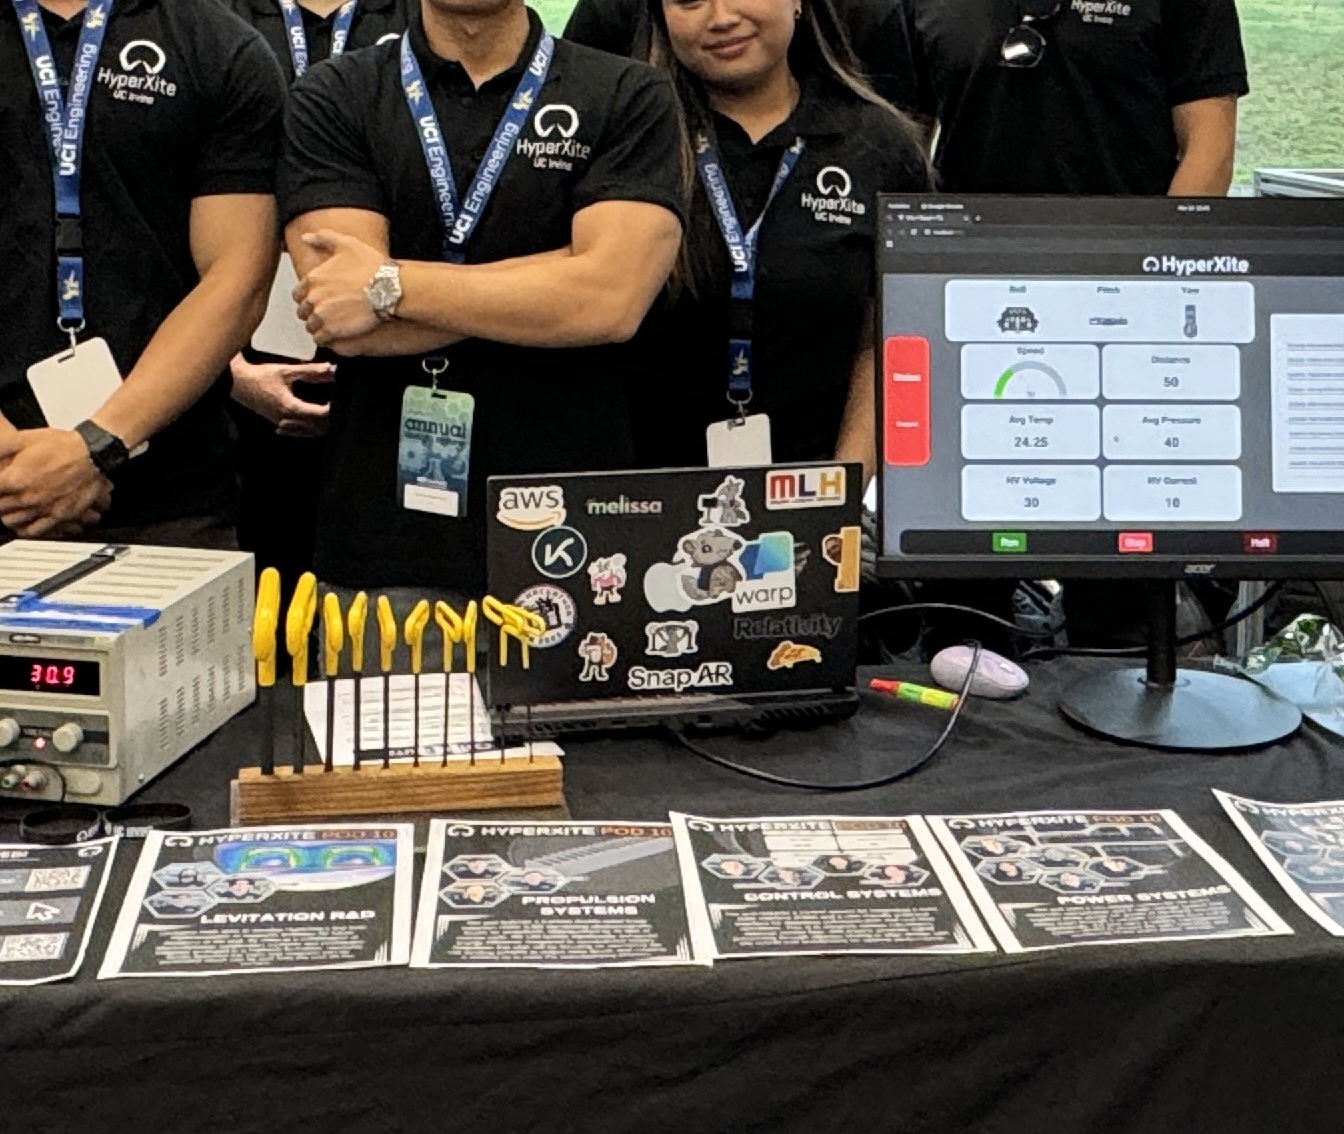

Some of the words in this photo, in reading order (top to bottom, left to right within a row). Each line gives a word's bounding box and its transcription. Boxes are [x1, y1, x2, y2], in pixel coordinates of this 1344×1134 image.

[290, 26, 305, 50] UCI
[35, 55, 56, 86] UCI
[529, 49, 548, 77] UCI
[96, 66, 177, 97] HyperXite
[64, 43, 98, 140] Engineering
[113, 89, 127, 101] UC
[419, 115, 438, 144] UCI
[516, 137, 591, 162] HyperXite
[59, 144, 76, 176] UCI
[532, 157, 547, 168] UC
[449, 212, 474, 245] UCI
[463, 122, 520, 214] Engineering
[801, 192, 866, 215] HyperXite
[730, 244, 748, 273] UCI
[1162, 256, 1250, 276] HyperXite
[1017, 347, 1045, 357] Speed
[1151, 355, 1191, 365] Distance
[1164, 376, 1179, 388] 50
[1008, 416, 1026, 426] Avg
[1028, 415, 1054, 426] Temp
[1142, 416, 1159, 426] Avg
[1161, 415, 1202, 426] Pressure
[405, 418, 467, 439] annual
[1014, 437, 1049, 448] 24.25
[1164, 437, 1179, 448] 40
[769, 470, 843, 499] MLH
[1022, 476, 1056, 485] Voltage
[1164, 476, 1198, 485] Current
[502, 490, 560, 510] aws
[587, 494, 663, 515] melissa
[1024, 497, 1040, 508] 30
[1165, 497, 1181, 508] 10
[736, 586, 794, 606] warp
[629, 667, 692, 689] Snap
[696, 664, 731, 684] AR
[719, 820, 831, 833] HYPERXITE
[977, 815, 1088, 828] HYPERXITE
[198, 831, 316, 846] HYPERXITE
[480, 826, 596, 837] HYPERXITE
[600, 826, 645, 837] POD
[522, 894, 656, 906] PROPULSION
[743, 891, 844, 902] CONTROL
[846, 888, 943, 899] SYSTEMS
[1056, 894, 1134, 906] POWER
[1136, 885, 1232, 901] SYSTEMS
[200, 911, 325, 924] LEVITATION
[330, 909, 376, 921] R&D
[540, 906, 639, 916] SYSTEMS
